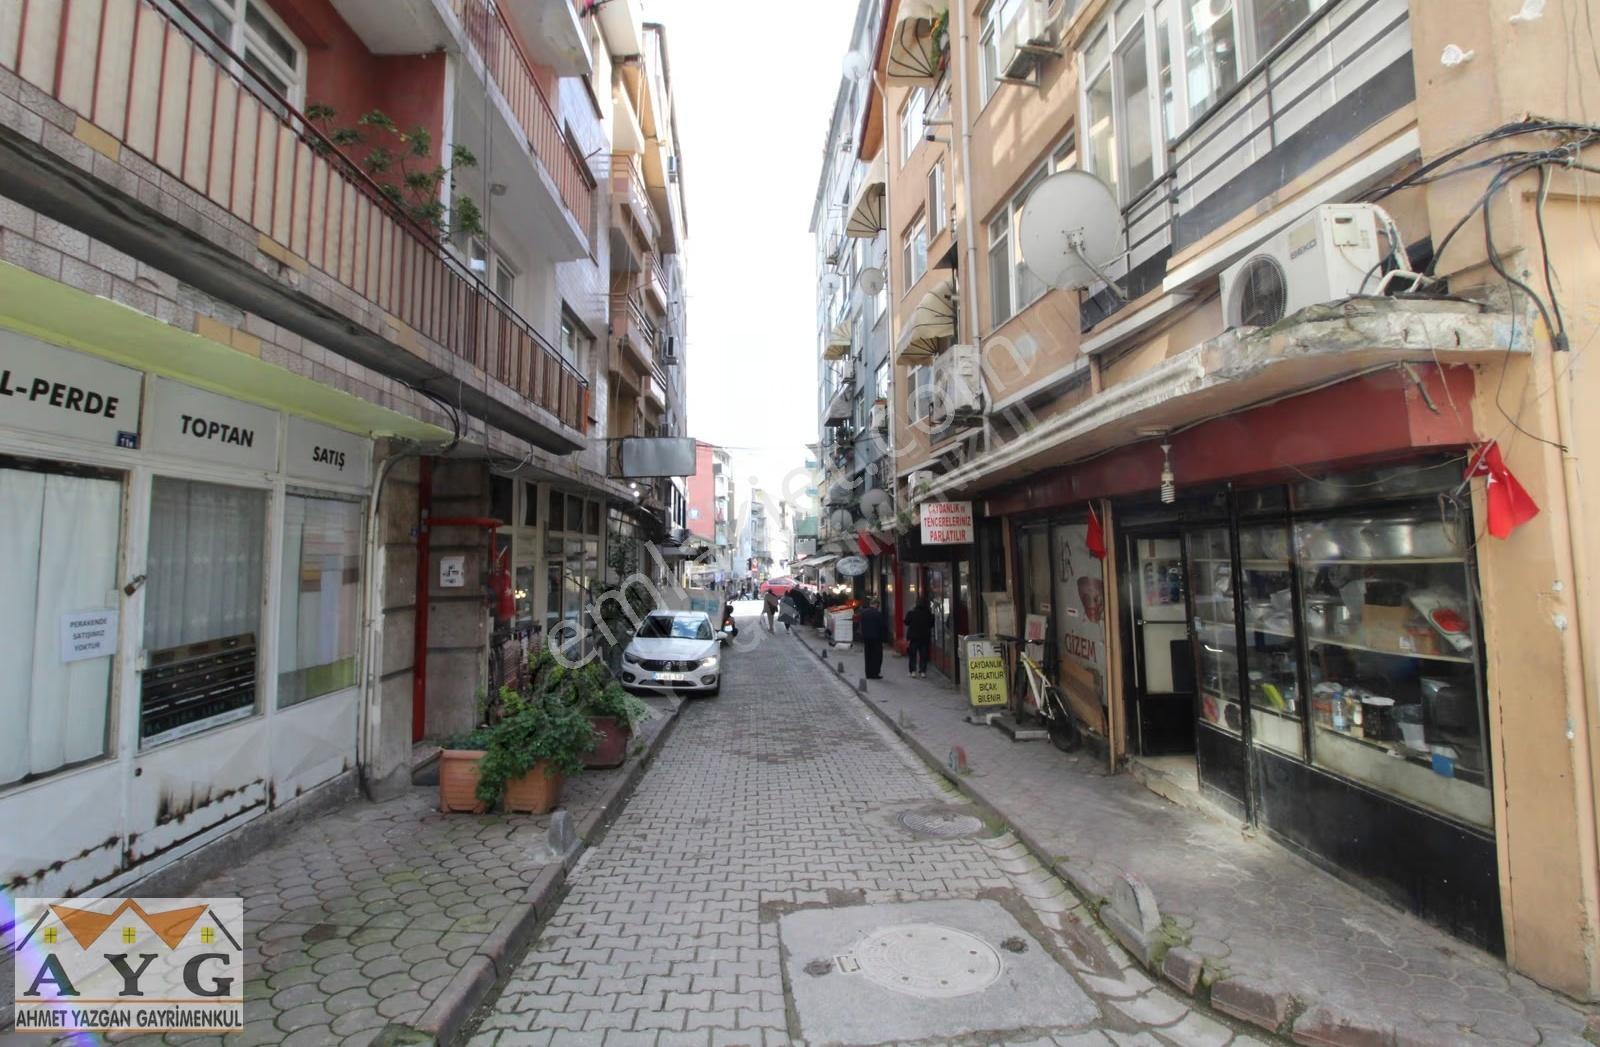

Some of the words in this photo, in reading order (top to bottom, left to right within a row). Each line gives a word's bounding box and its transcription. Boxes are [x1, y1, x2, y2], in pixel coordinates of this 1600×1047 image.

[0, 370, 119, 419] L-PERDE
[181, 415, 254, 447] TOPTAN
[312, 446, 346, 471] SATIŞ
[930, 530, 966, 541] PARLATILIR
[971, 671, 1004, 680] PARLATILIR
